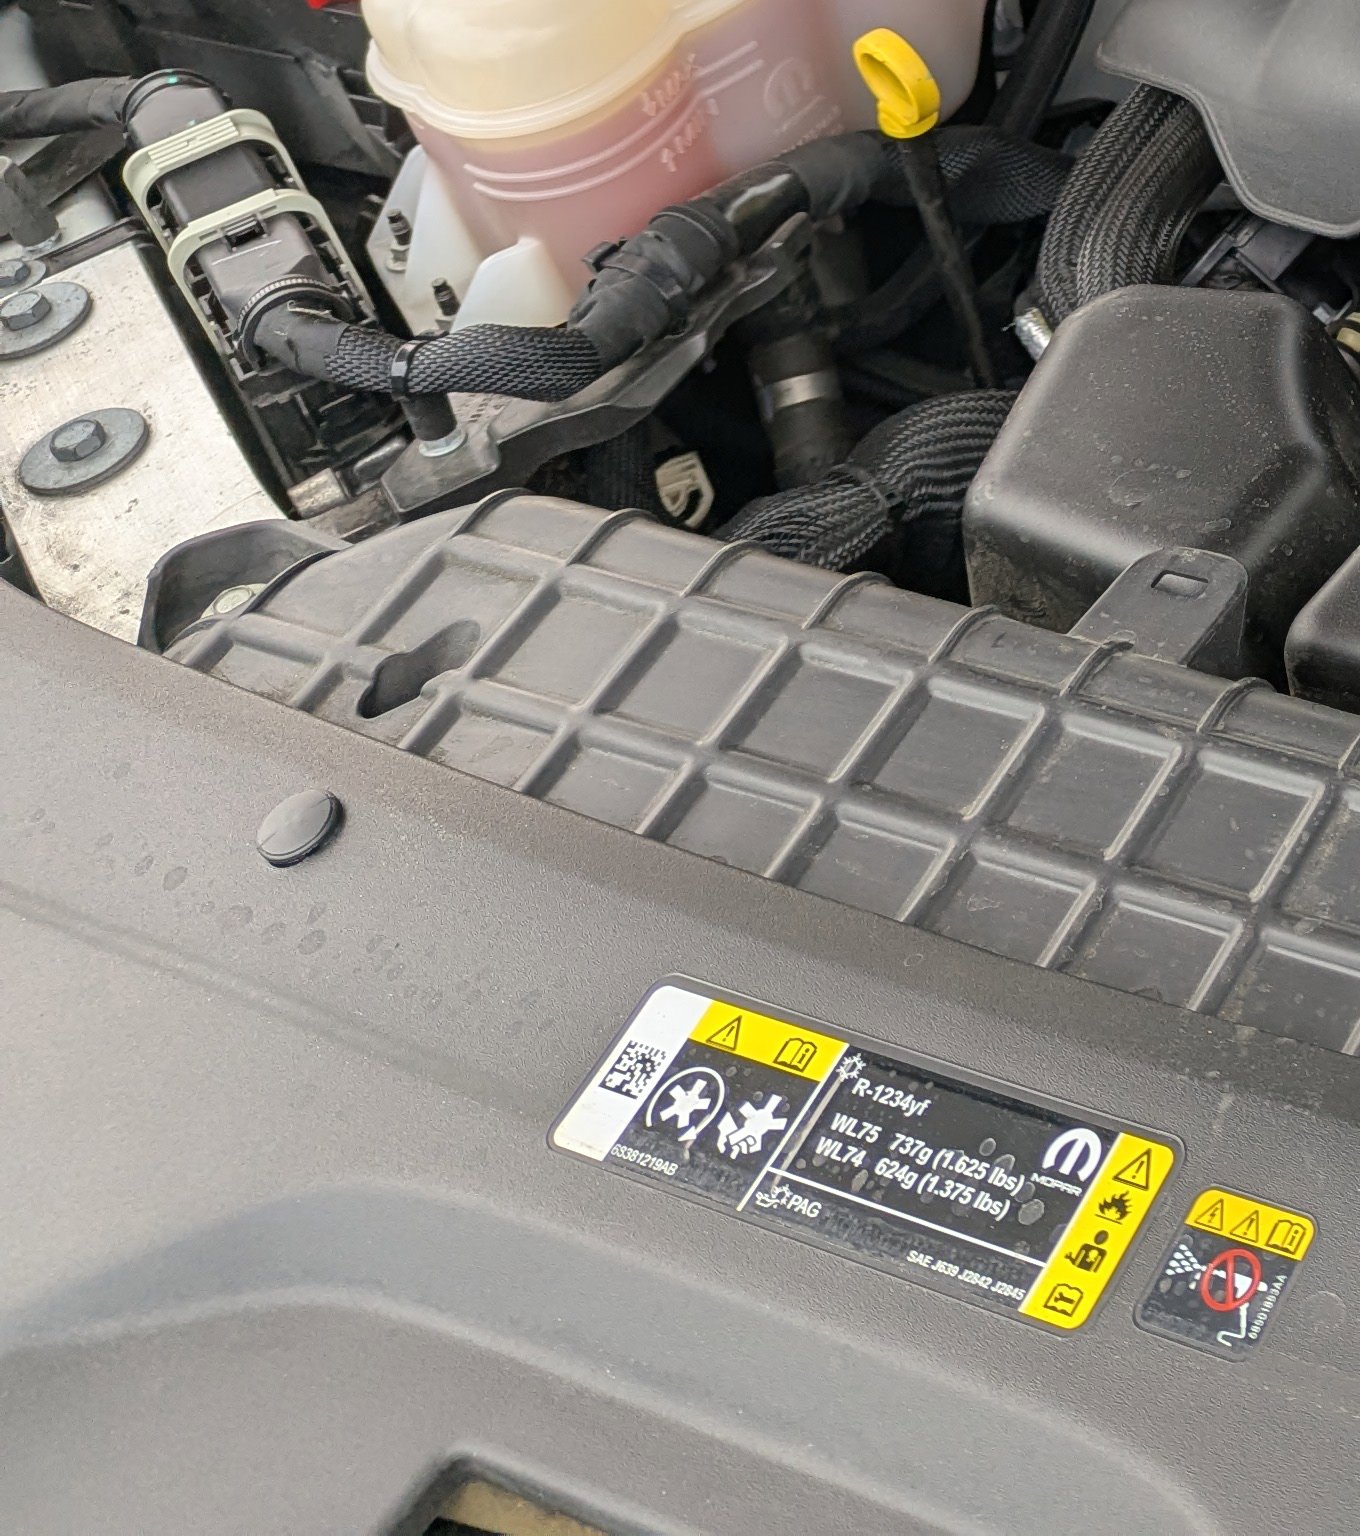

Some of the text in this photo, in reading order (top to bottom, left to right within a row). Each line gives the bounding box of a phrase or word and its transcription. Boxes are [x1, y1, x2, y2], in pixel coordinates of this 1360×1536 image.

[852, 1078, 930, 1116] R-1234yf
[830, 1112, 1026, 1197] WL75 737g (1.625 lbs)
[815, 1136, 1011, 1222] WL74 624g (1.375 lbs)
[1030, 1172, 1083, 1198] MOPAR
[786, 1194, 822, 1218] PAG
[906, 1249, 934, 1268] SAE
